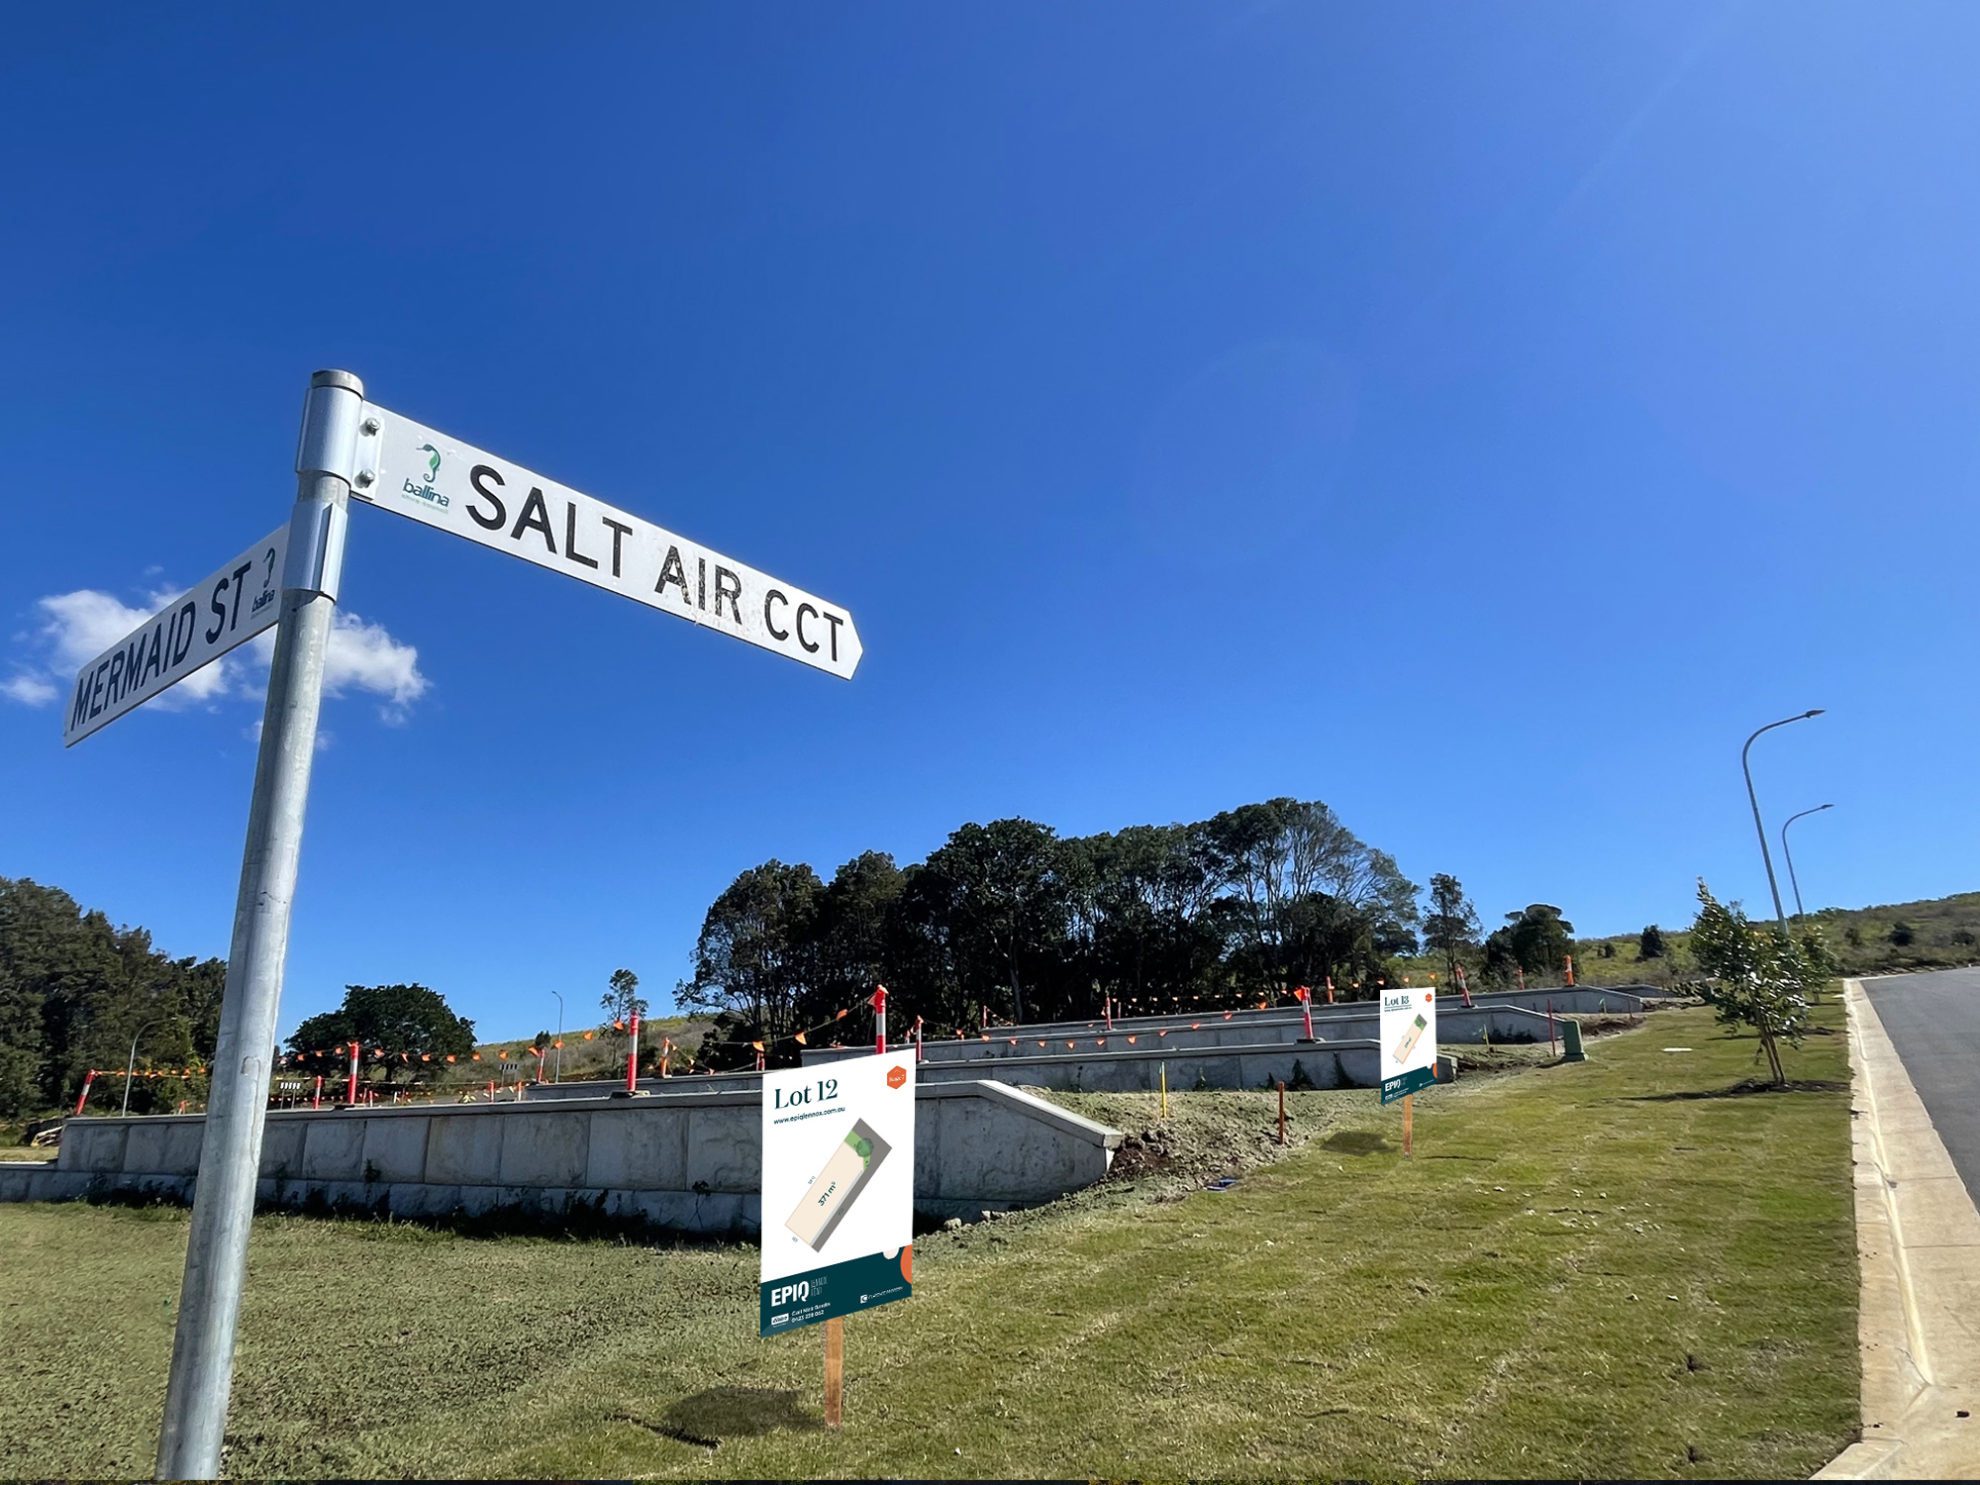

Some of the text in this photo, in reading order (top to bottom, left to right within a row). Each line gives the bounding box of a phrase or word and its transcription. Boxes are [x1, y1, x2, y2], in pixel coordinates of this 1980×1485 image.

[402, 477, 450, 507] ballina
[466, 464, 844, 662] SALT AIR CCT
[252, 589, 276, 612] ballina
[70, 561, 252, 731] MERMAID ST
[1384, 996, 1399, 1006] Lot
[774, 1078, 838, 1110] Lot 12
[771, 1280, 810, 1307] EPIQ
